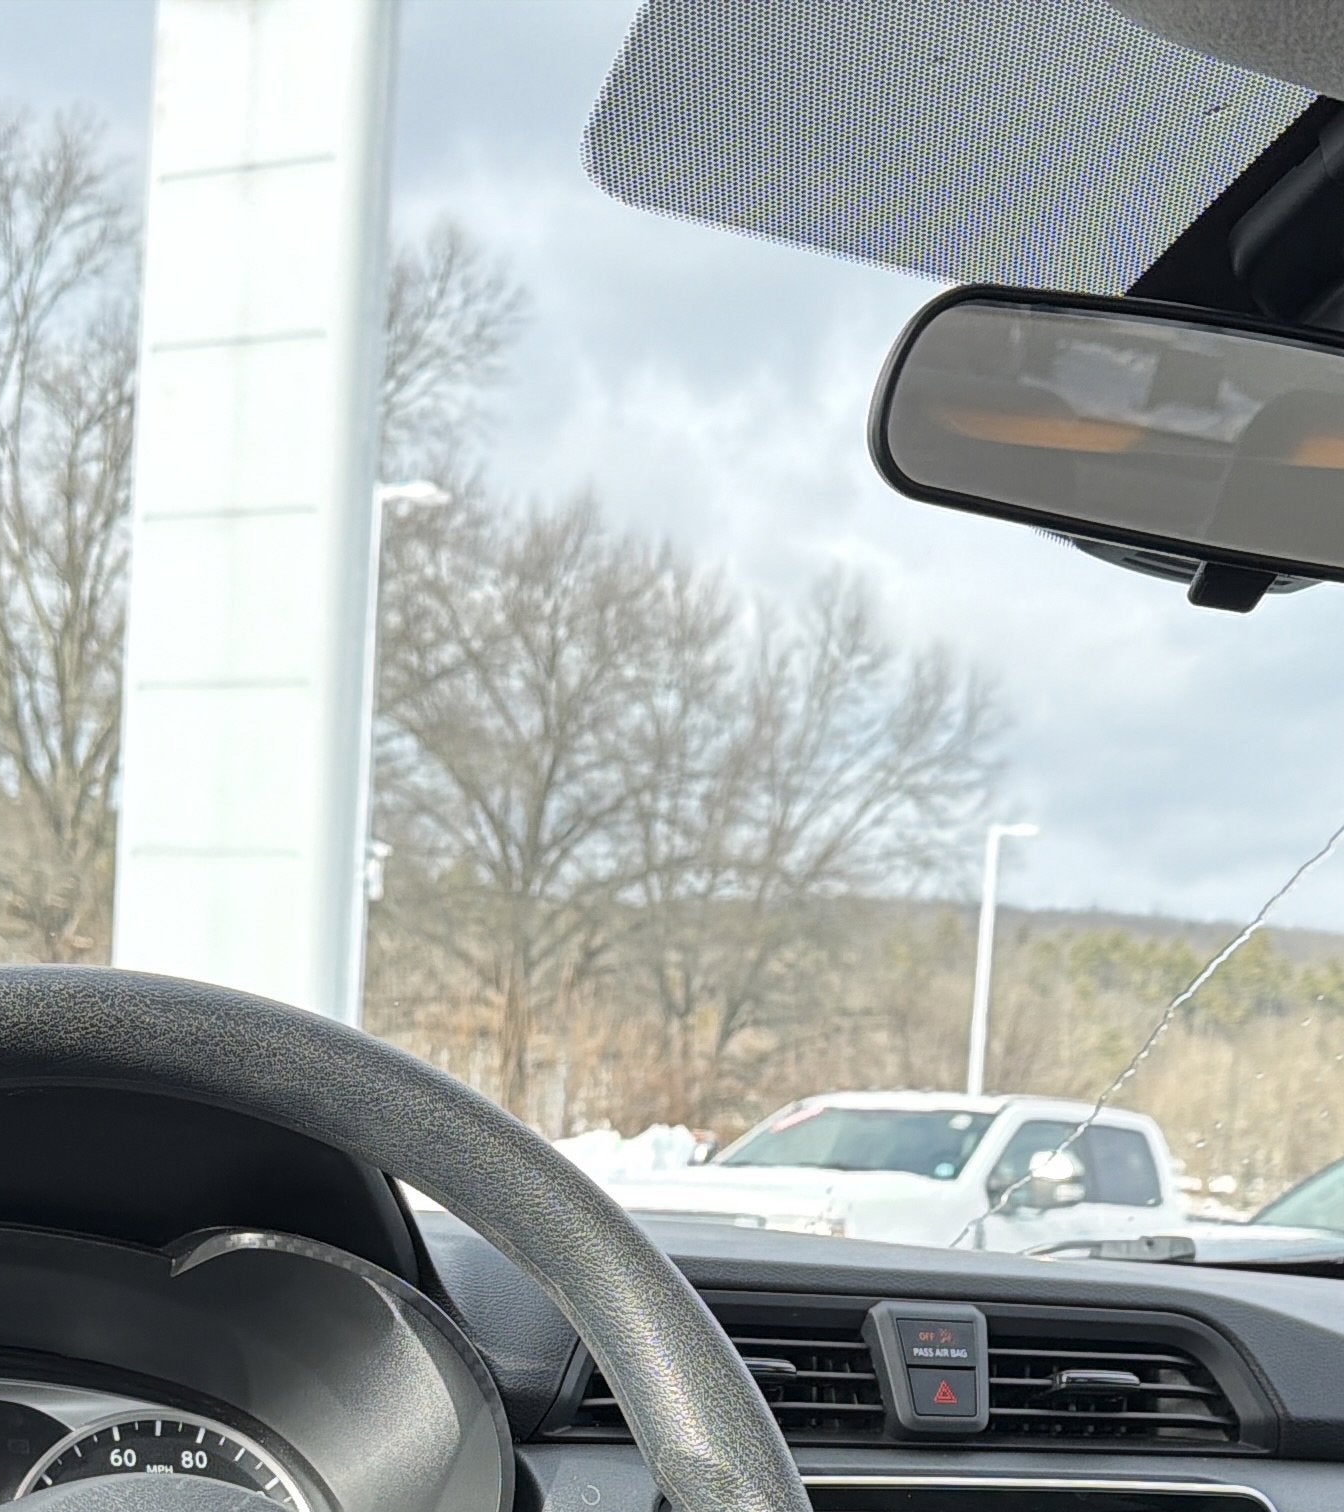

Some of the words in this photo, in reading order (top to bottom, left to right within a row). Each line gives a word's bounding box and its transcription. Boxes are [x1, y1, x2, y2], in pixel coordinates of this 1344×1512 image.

[919, 1331, 936, 1341] OFF
[913, 1348, 934, 1357] PASS
[936, 1348, 949, 1357] AIR
[951, 1349, 968, 1358] BAG
[110, 1449, 136, 1467] 60
[181, 1451, 207, 1469] 80
[146, 1464, 174, 1474] MPH
